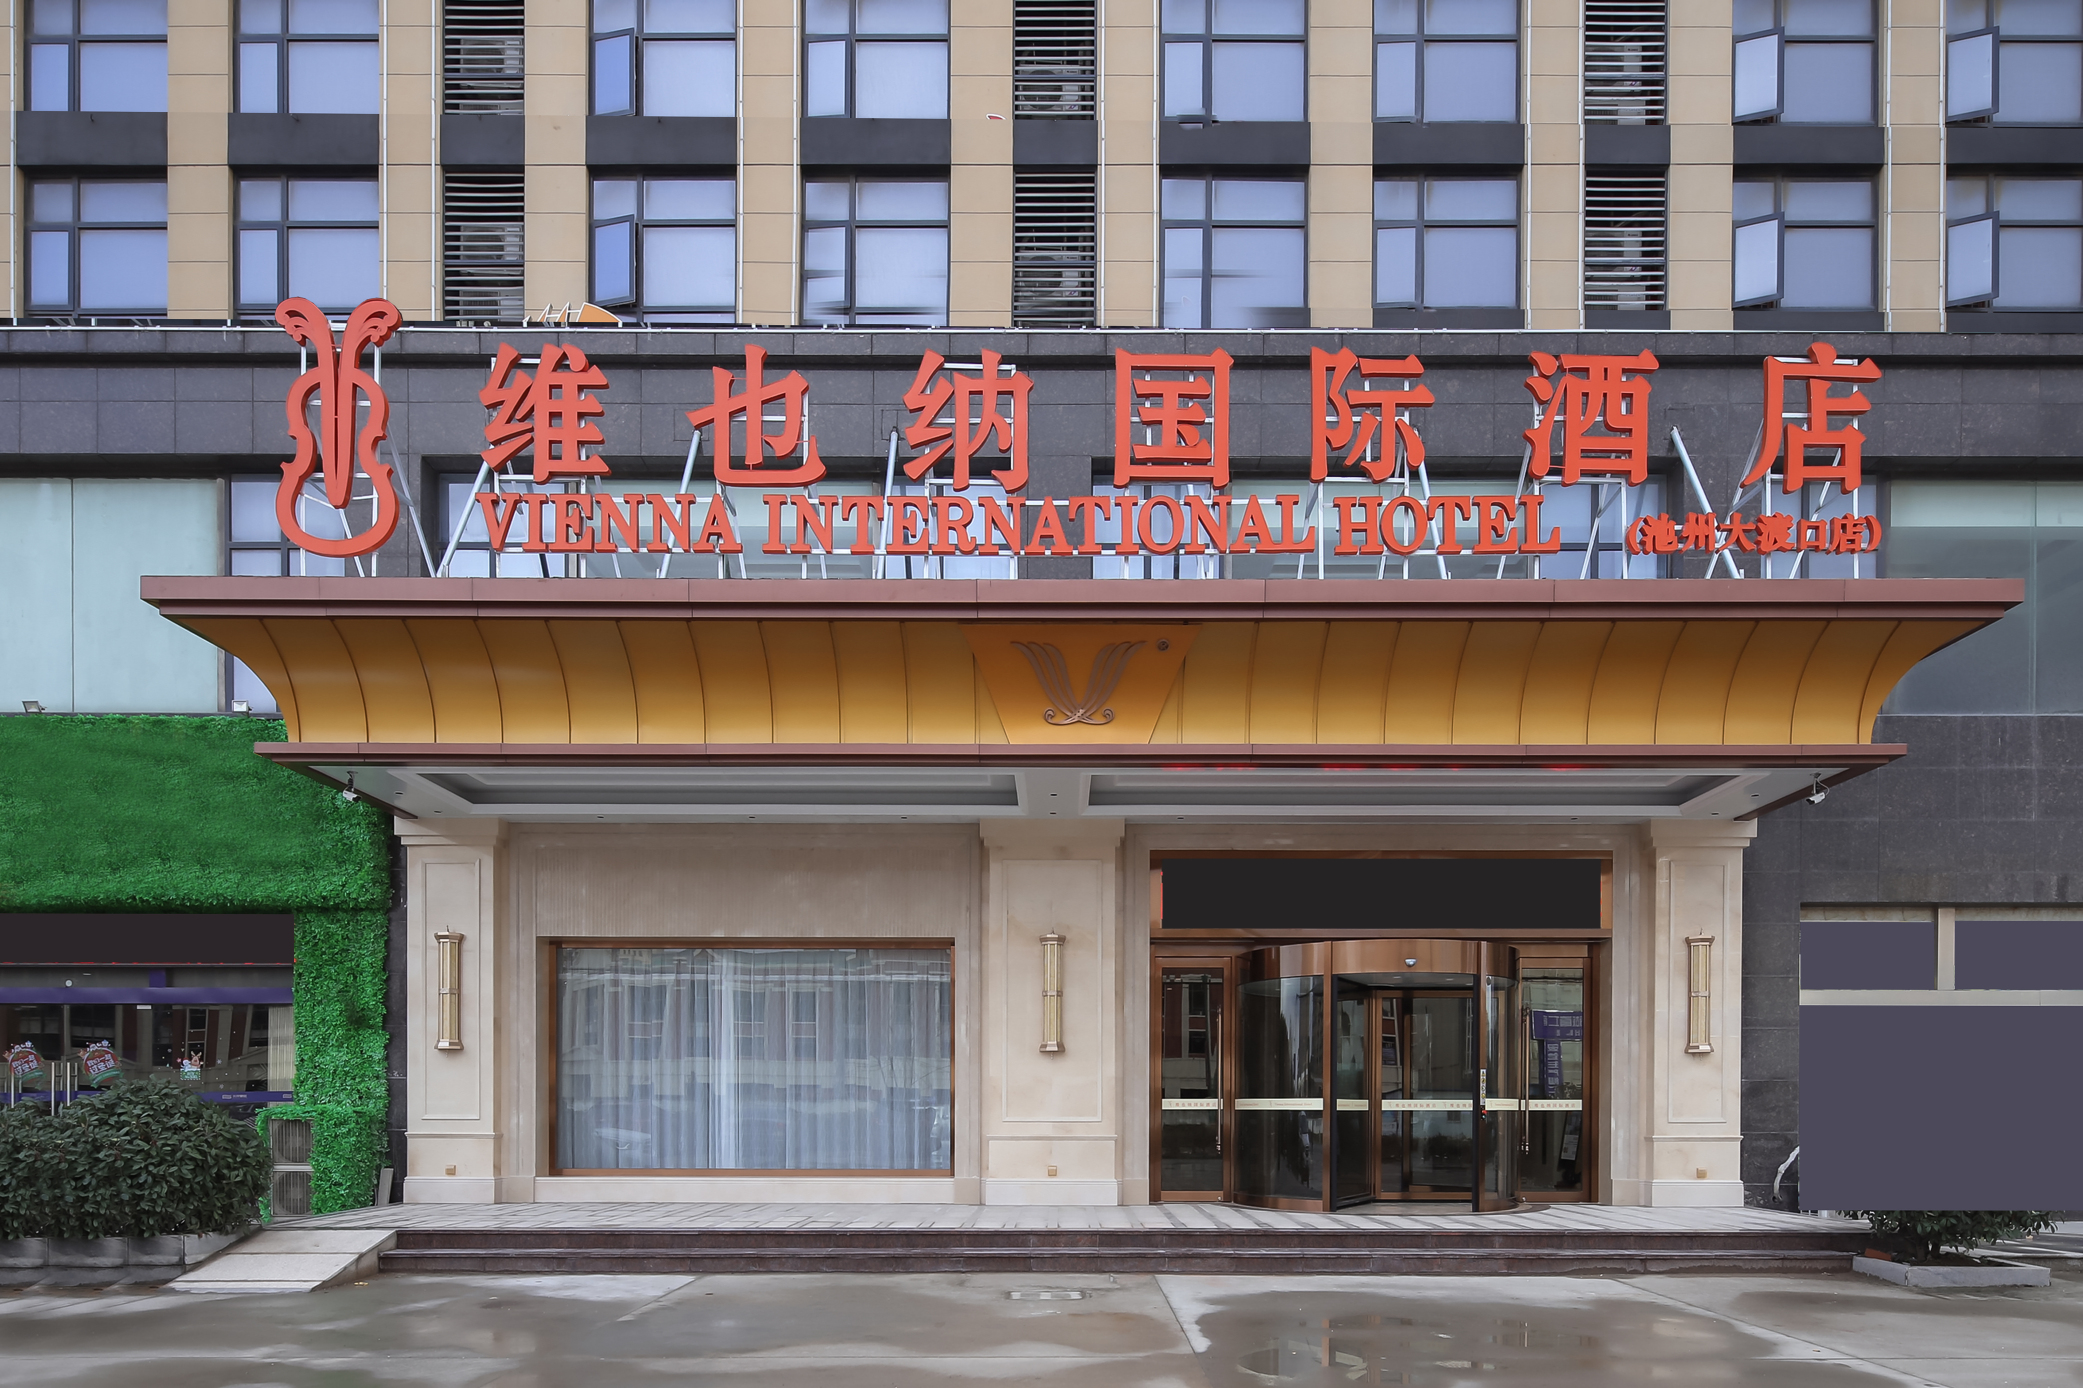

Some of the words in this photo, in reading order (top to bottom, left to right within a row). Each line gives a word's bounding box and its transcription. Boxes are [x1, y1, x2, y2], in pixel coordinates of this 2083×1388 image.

[479, 342, 1882, 490] 维也纳国际酒店
[476, 493, 743, 554] VIENNA
[763, 495, 1315, 557] INTERNATIONAL
[1333, 496, 1561, 556] HOTEL
